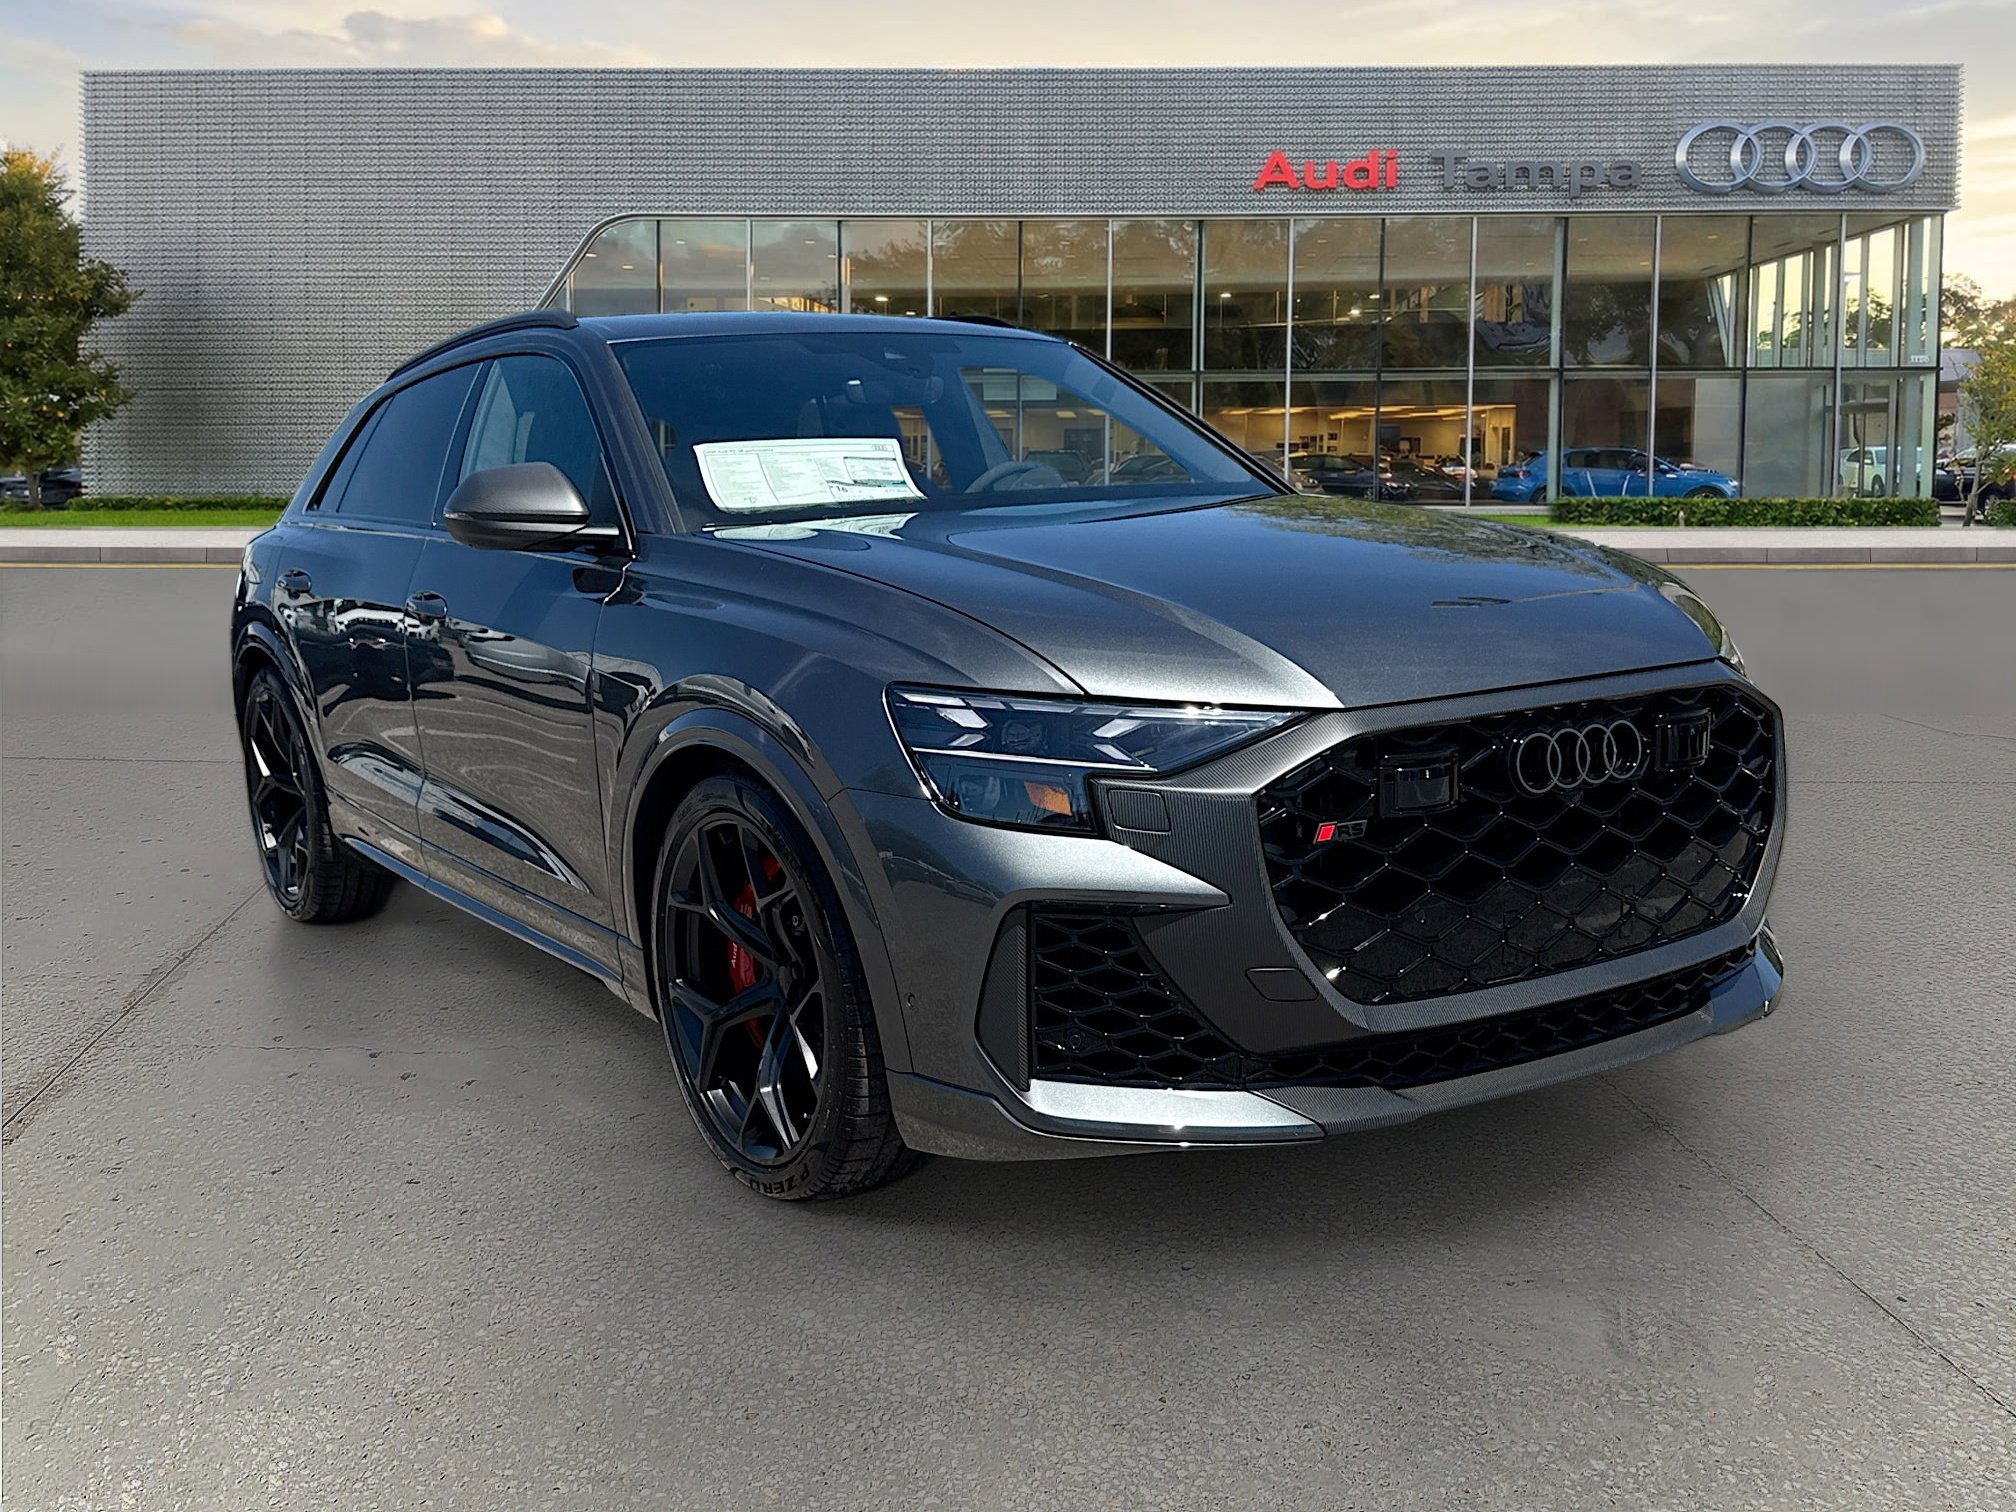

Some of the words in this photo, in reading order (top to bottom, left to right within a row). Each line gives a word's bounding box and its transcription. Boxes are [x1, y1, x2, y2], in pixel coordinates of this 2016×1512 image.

[1253, 148, 1398, 190] Audi
[1431, 149, 1642, 199] Tampa
[730, 941, 738, 968] Aud
[800, 1162, 810, 1182] P
[749, 1175, 797, 1195] ZERO
